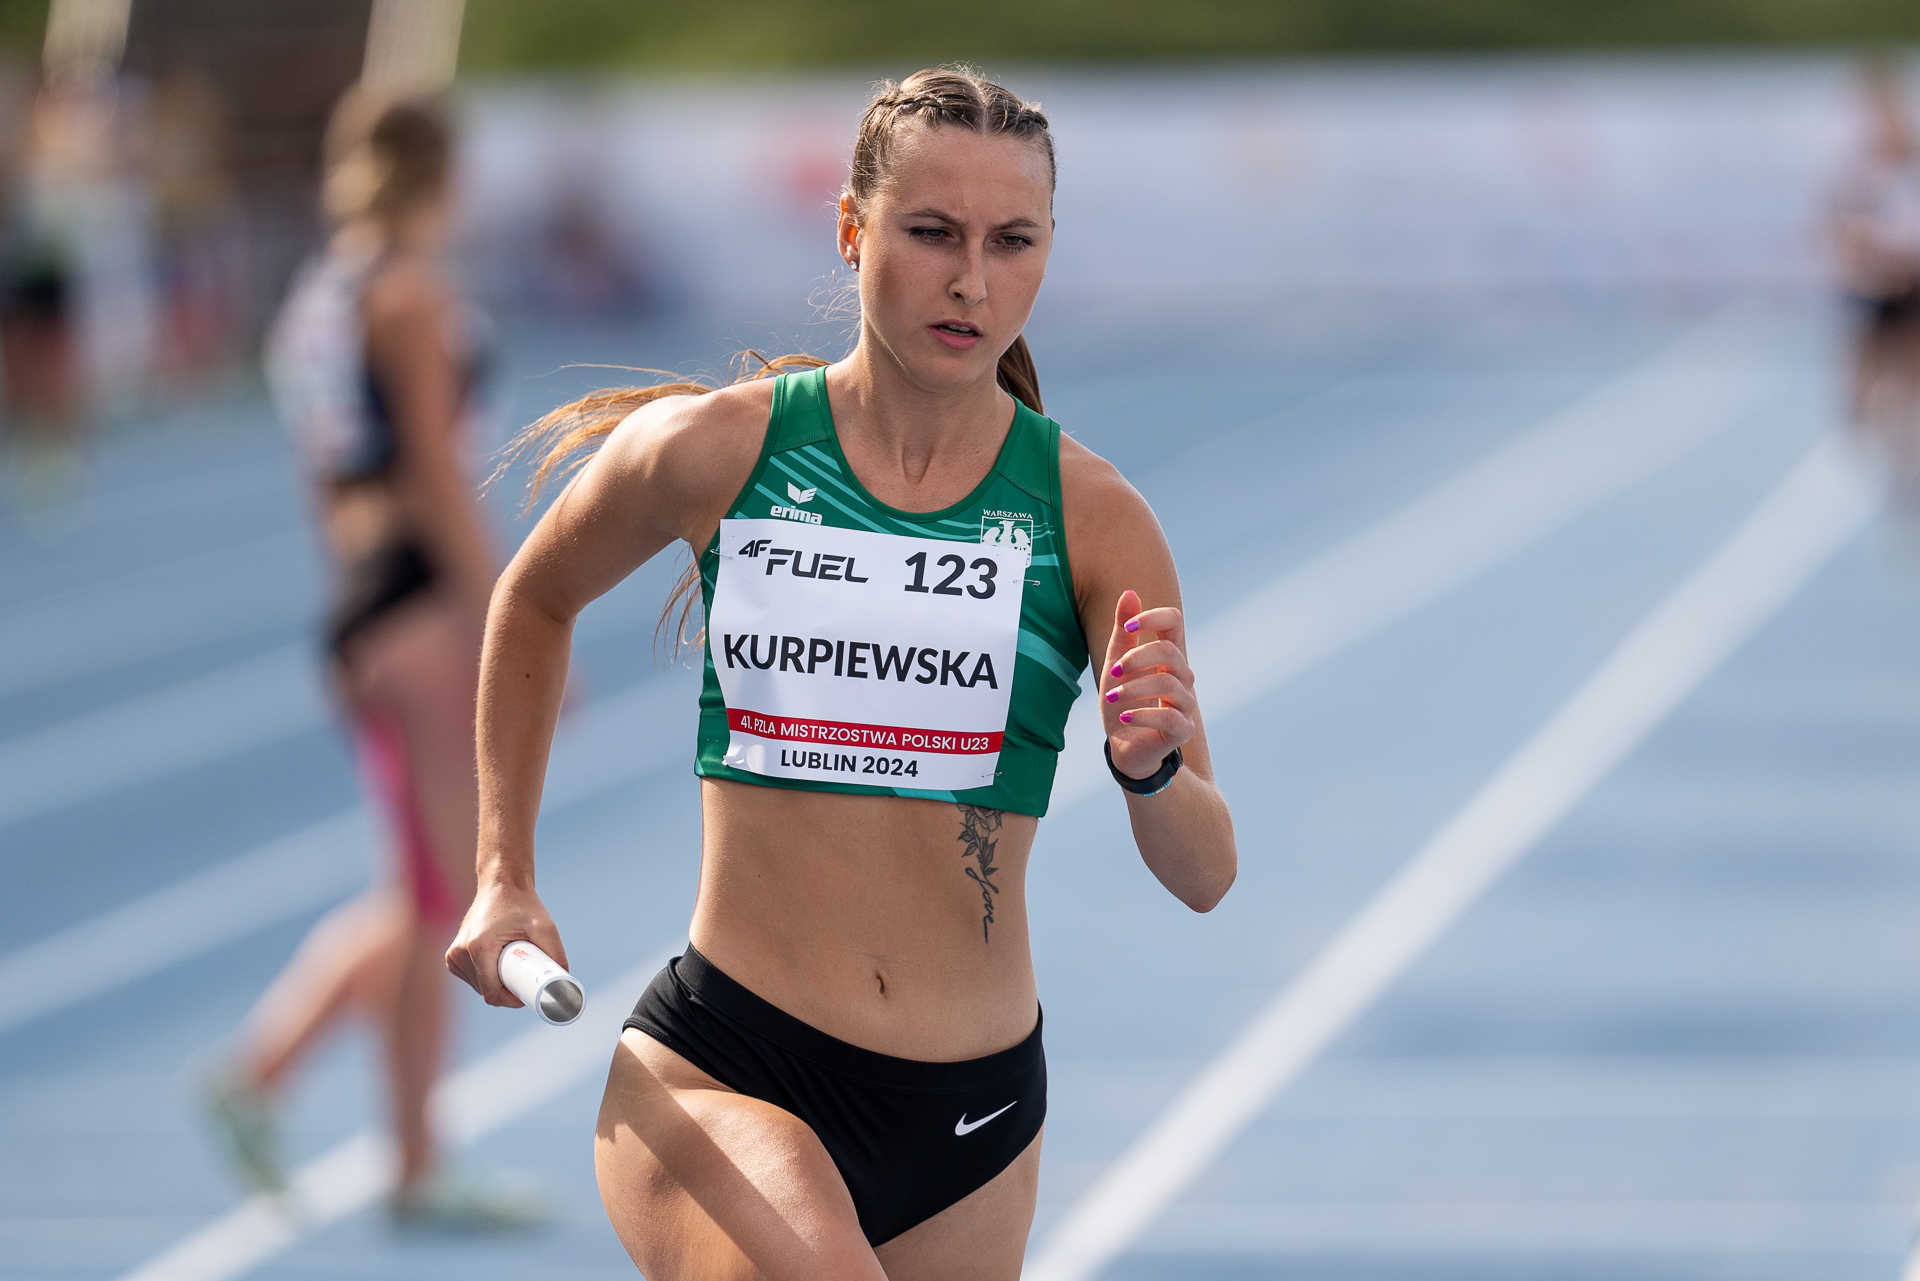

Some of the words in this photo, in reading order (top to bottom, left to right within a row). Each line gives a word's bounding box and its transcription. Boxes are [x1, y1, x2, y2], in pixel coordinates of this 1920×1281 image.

[770, 505, 823, 526] erima
[982, 508, 1034, 519] WARSZAWA
[738, 539, 773, 558] 4F
[765, 548, 870, 584] FUEL
[904, 551, 998, 600] 123
[723, 633, 999, 690] KURPIEWSKA
[740, 715, 753, 730] 41.
[754, 718, 776, 735] PZLA
[780, 722, 897, 746] MISTRZOSTWA
[901, 733, 957, 750] POLSKI
[960, 737, 990, 751] U23
[780, 749, 857, 773] LUBLIN
[862, 755, 919, 778] 2024
